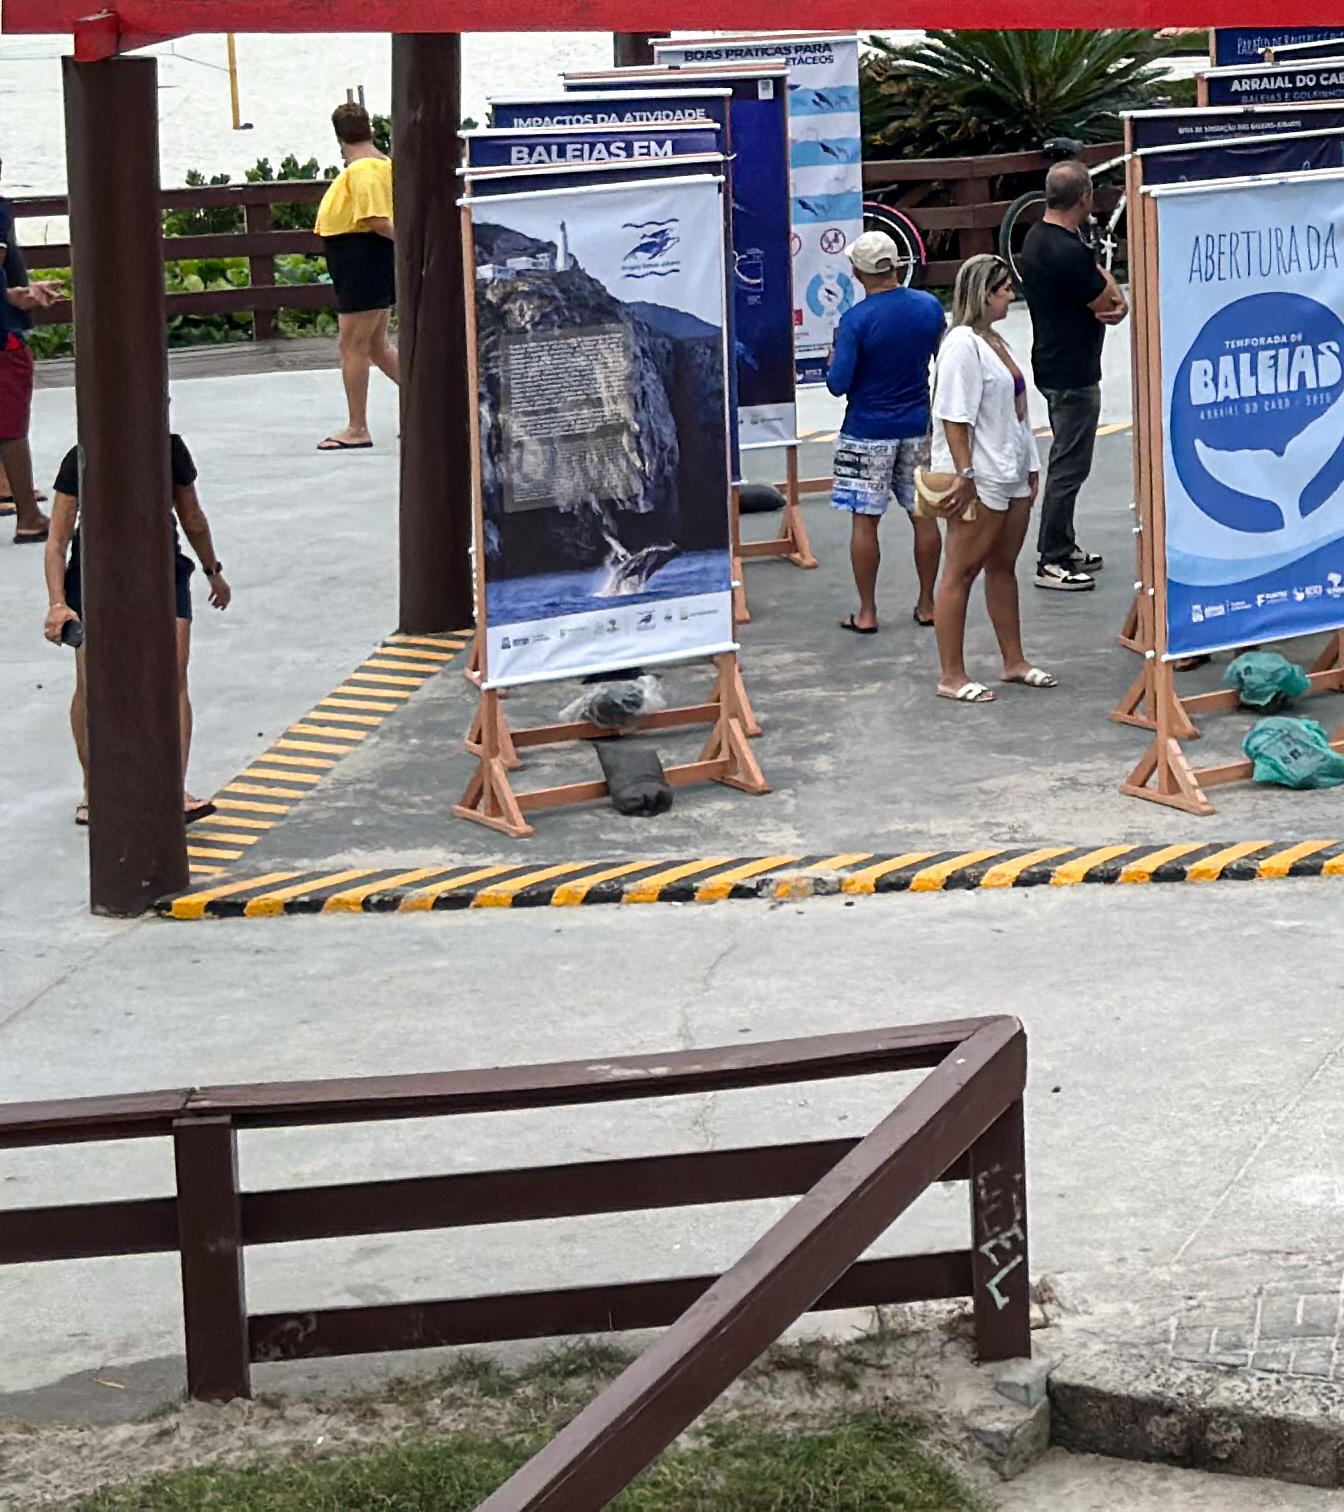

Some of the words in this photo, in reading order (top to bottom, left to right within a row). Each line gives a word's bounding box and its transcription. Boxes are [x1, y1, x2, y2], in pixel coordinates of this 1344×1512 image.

[684, 49, 722, 61] BOAS
[794, 42, 832, 54] PARA
[785, 54, 834, 66] ETÁCEOS
[1230, 75, 1293, 92] ARRAIAL
[1295, 74, 1317, 87] DO
[513, 114, 594, 129] IMPACTOS
[597, 112, 619, 125] DA
[623, 108, 706, 124] ATIVIDADE
[511, 141, 628, 165] BALEIAS
[632, 139, 673, 158] EM
[1188, 225, 1302, 283] ABERTURA
[1306, 222, 1338, 272] DA
[1224, 335, 1288, 350] TEMPORADA
[1290, 333, 1303, 342] DE
[1189, 340, 1343, 406] BALEIAS
